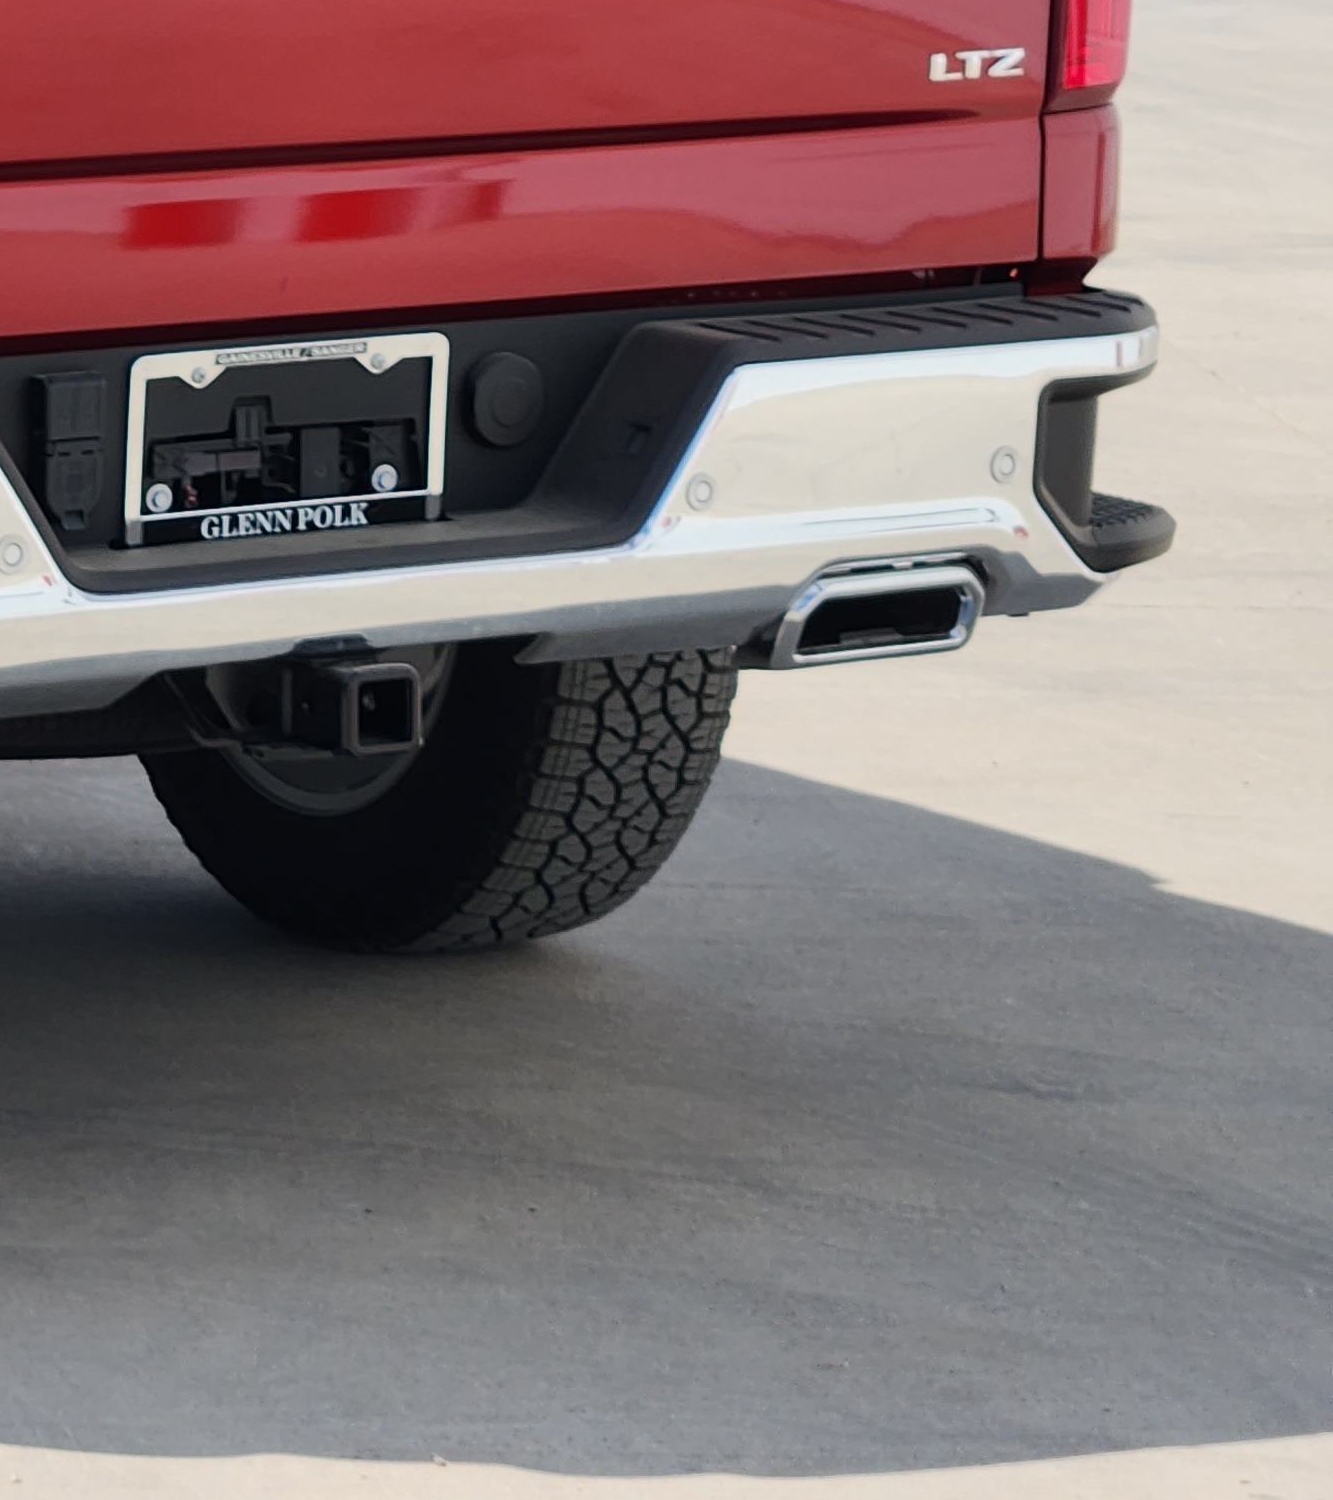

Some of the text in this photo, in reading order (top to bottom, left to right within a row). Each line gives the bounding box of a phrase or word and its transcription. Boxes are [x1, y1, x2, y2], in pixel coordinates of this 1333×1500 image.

[929, 47, 1025, 81] LTZ
[200, 502, 369, 540] GLENN POLK
